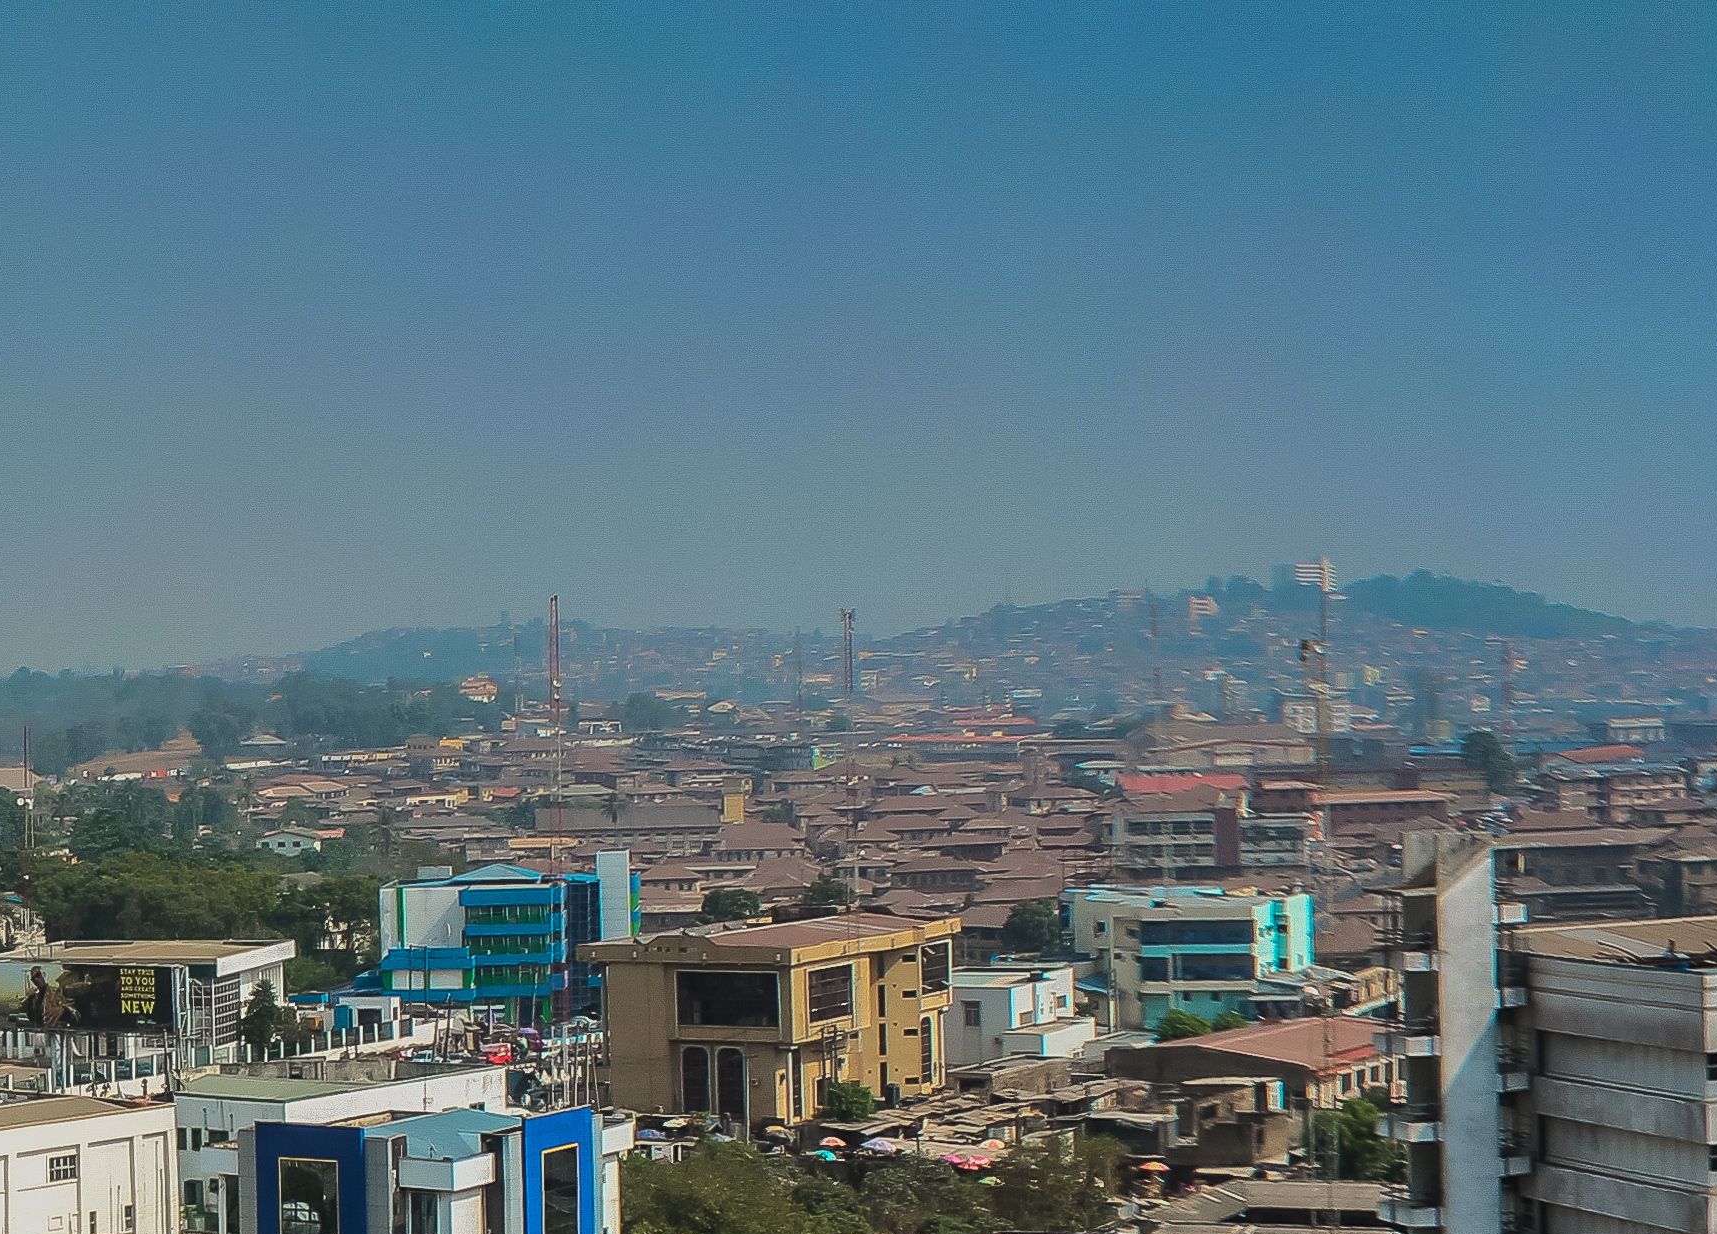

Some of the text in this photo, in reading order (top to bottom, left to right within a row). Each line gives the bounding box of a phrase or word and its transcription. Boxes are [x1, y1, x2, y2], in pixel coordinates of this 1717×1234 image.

[121, 976, 155, 986] TO YOU
[121, 1000, 155, 1015] NEW
